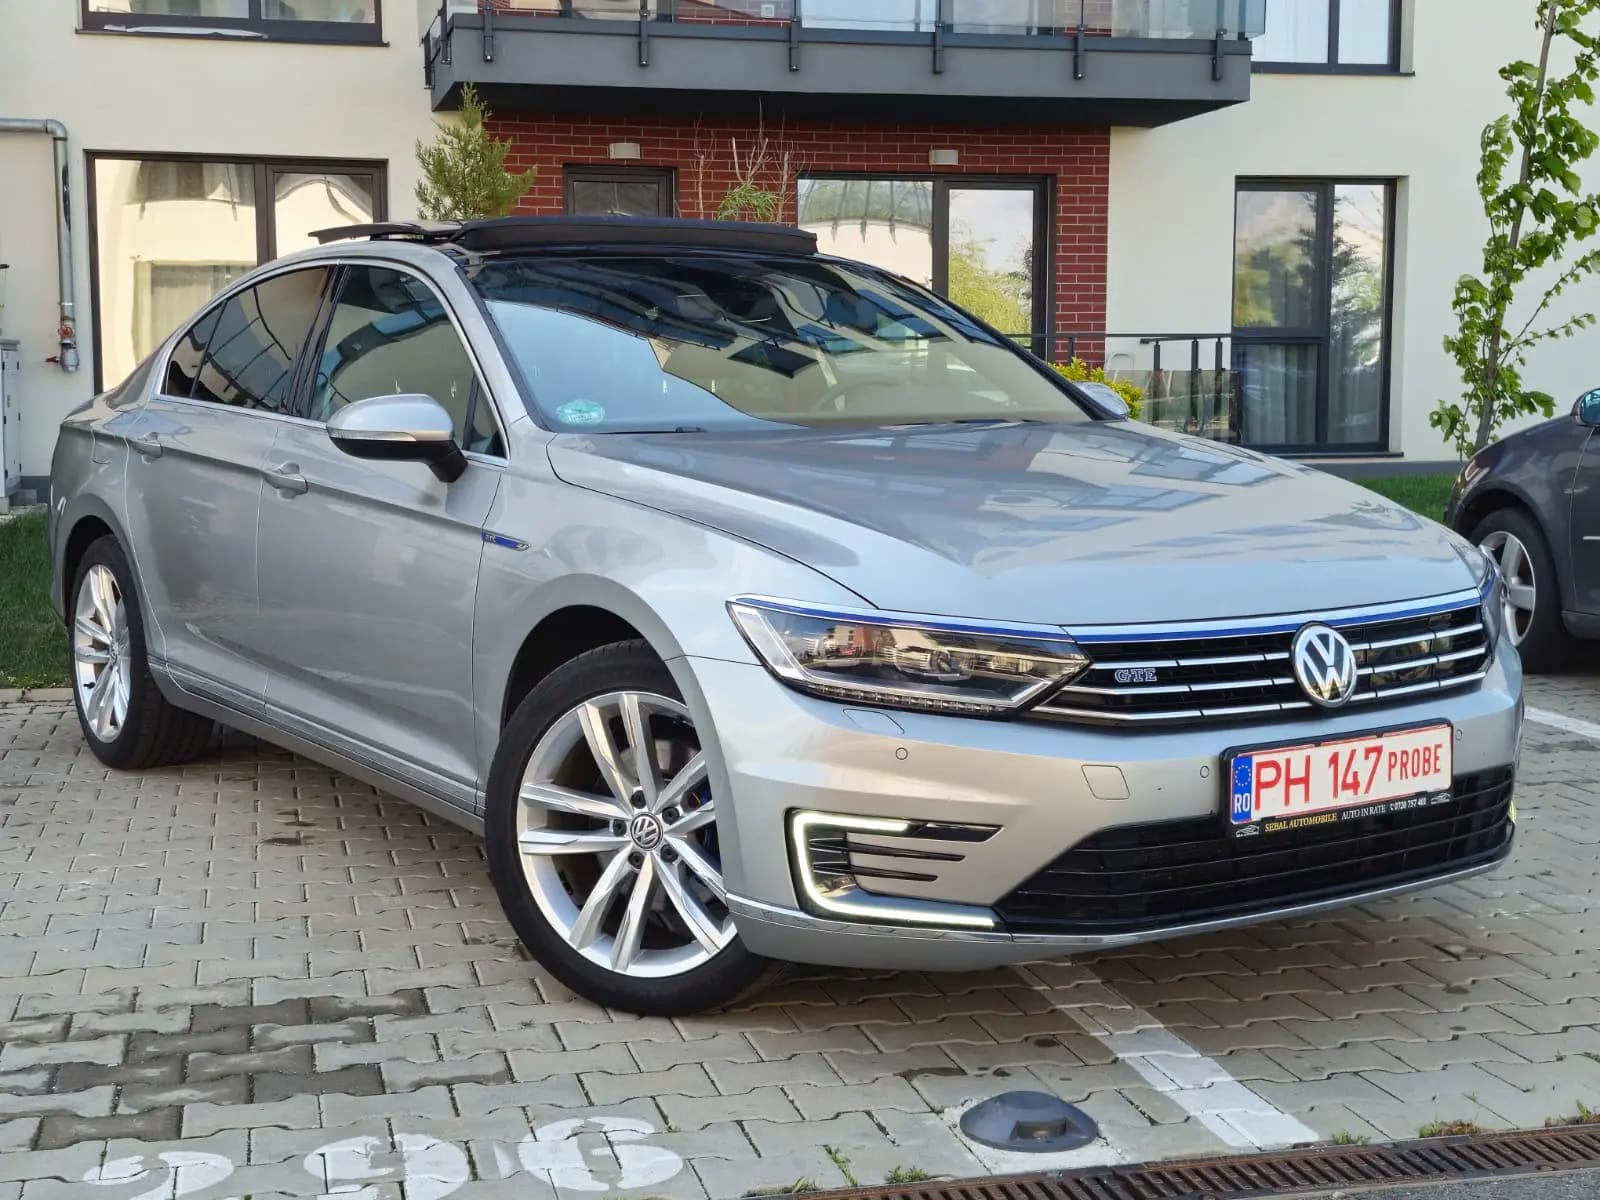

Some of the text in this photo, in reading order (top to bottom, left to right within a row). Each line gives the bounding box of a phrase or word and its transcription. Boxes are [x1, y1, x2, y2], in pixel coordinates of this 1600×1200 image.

[1114, 668, 1157, 683] GTE
[1254, 743, 1443, 811] PH 147 PROBE
[1234, 792, 1251, 814] RO
[1289, 812, 1338, 830] AUTOMOBILE
[1341, 807, 1360, 821] AUTO
[1360, 806, 1369, 817] IN
[1369, 803, 1386, 816] RATE
